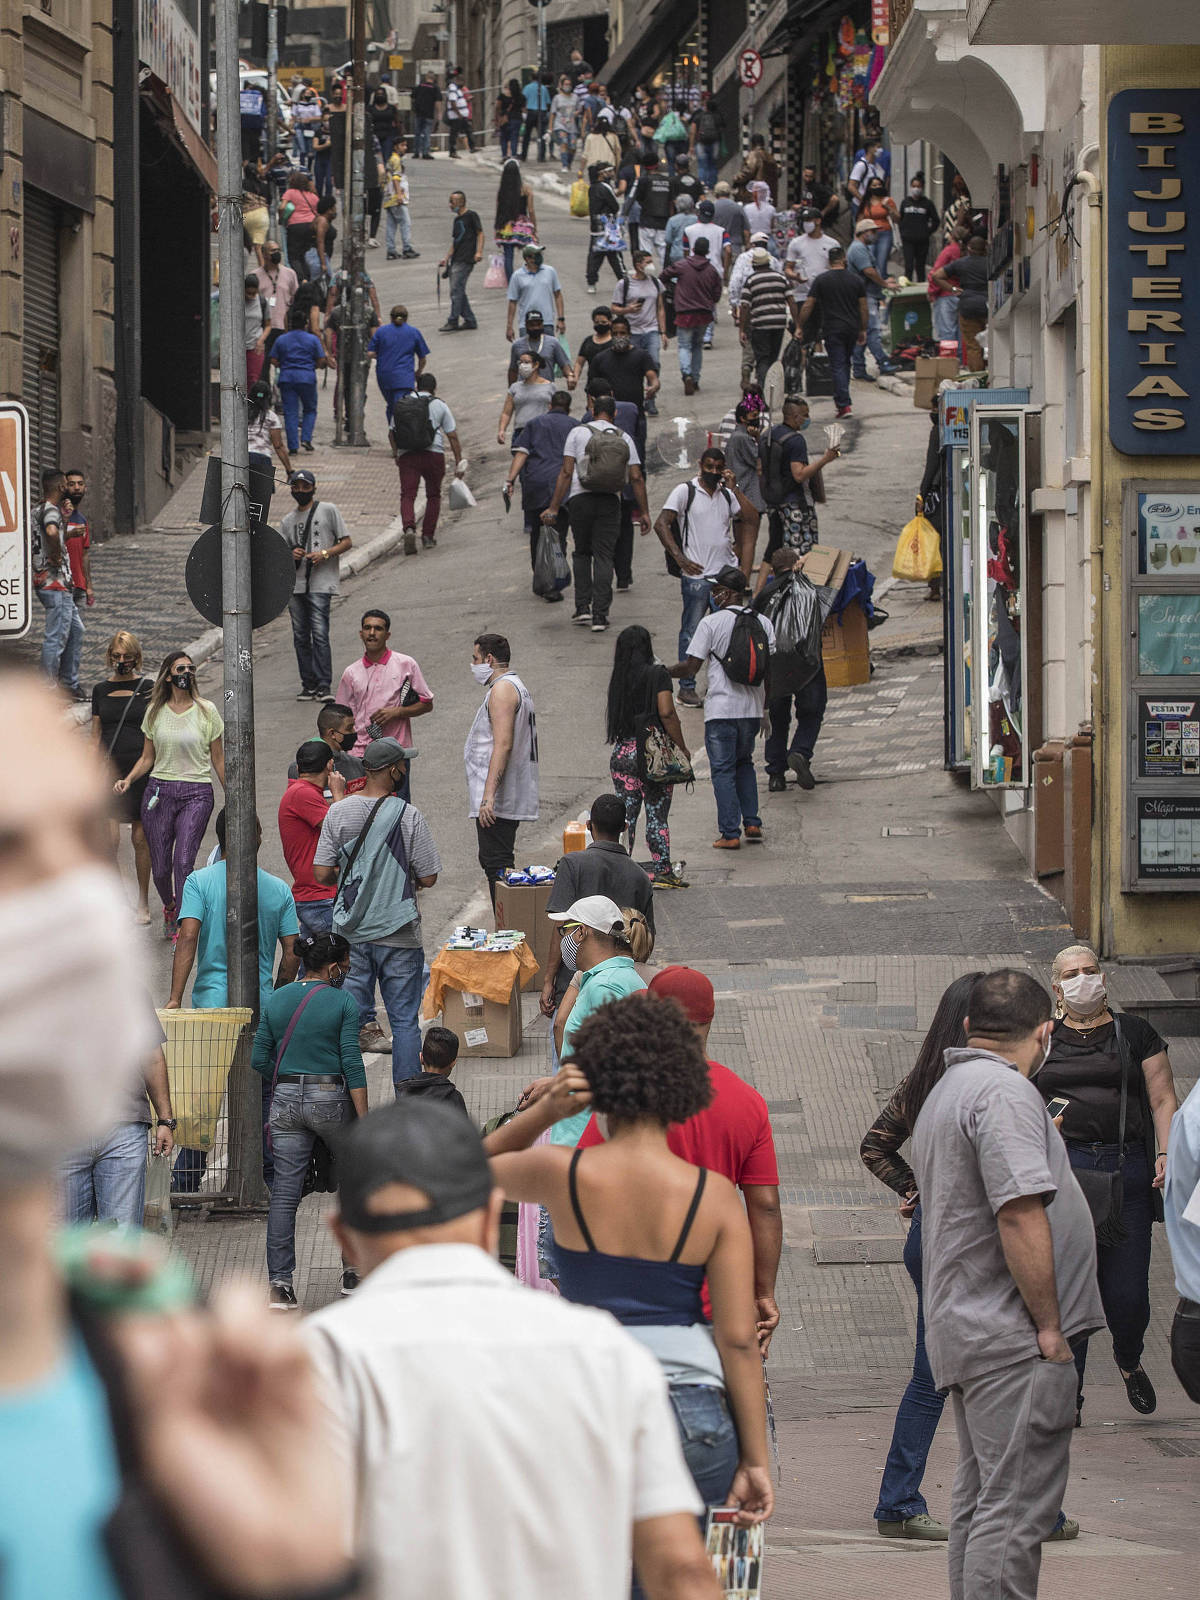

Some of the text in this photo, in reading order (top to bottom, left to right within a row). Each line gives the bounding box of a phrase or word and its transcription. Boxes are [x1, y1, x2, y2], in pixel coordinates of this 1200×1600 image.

[1126, 112, 1190, 431] BIJUTERIAS
[1151, 705, 1191, 713] FESTA TOP
